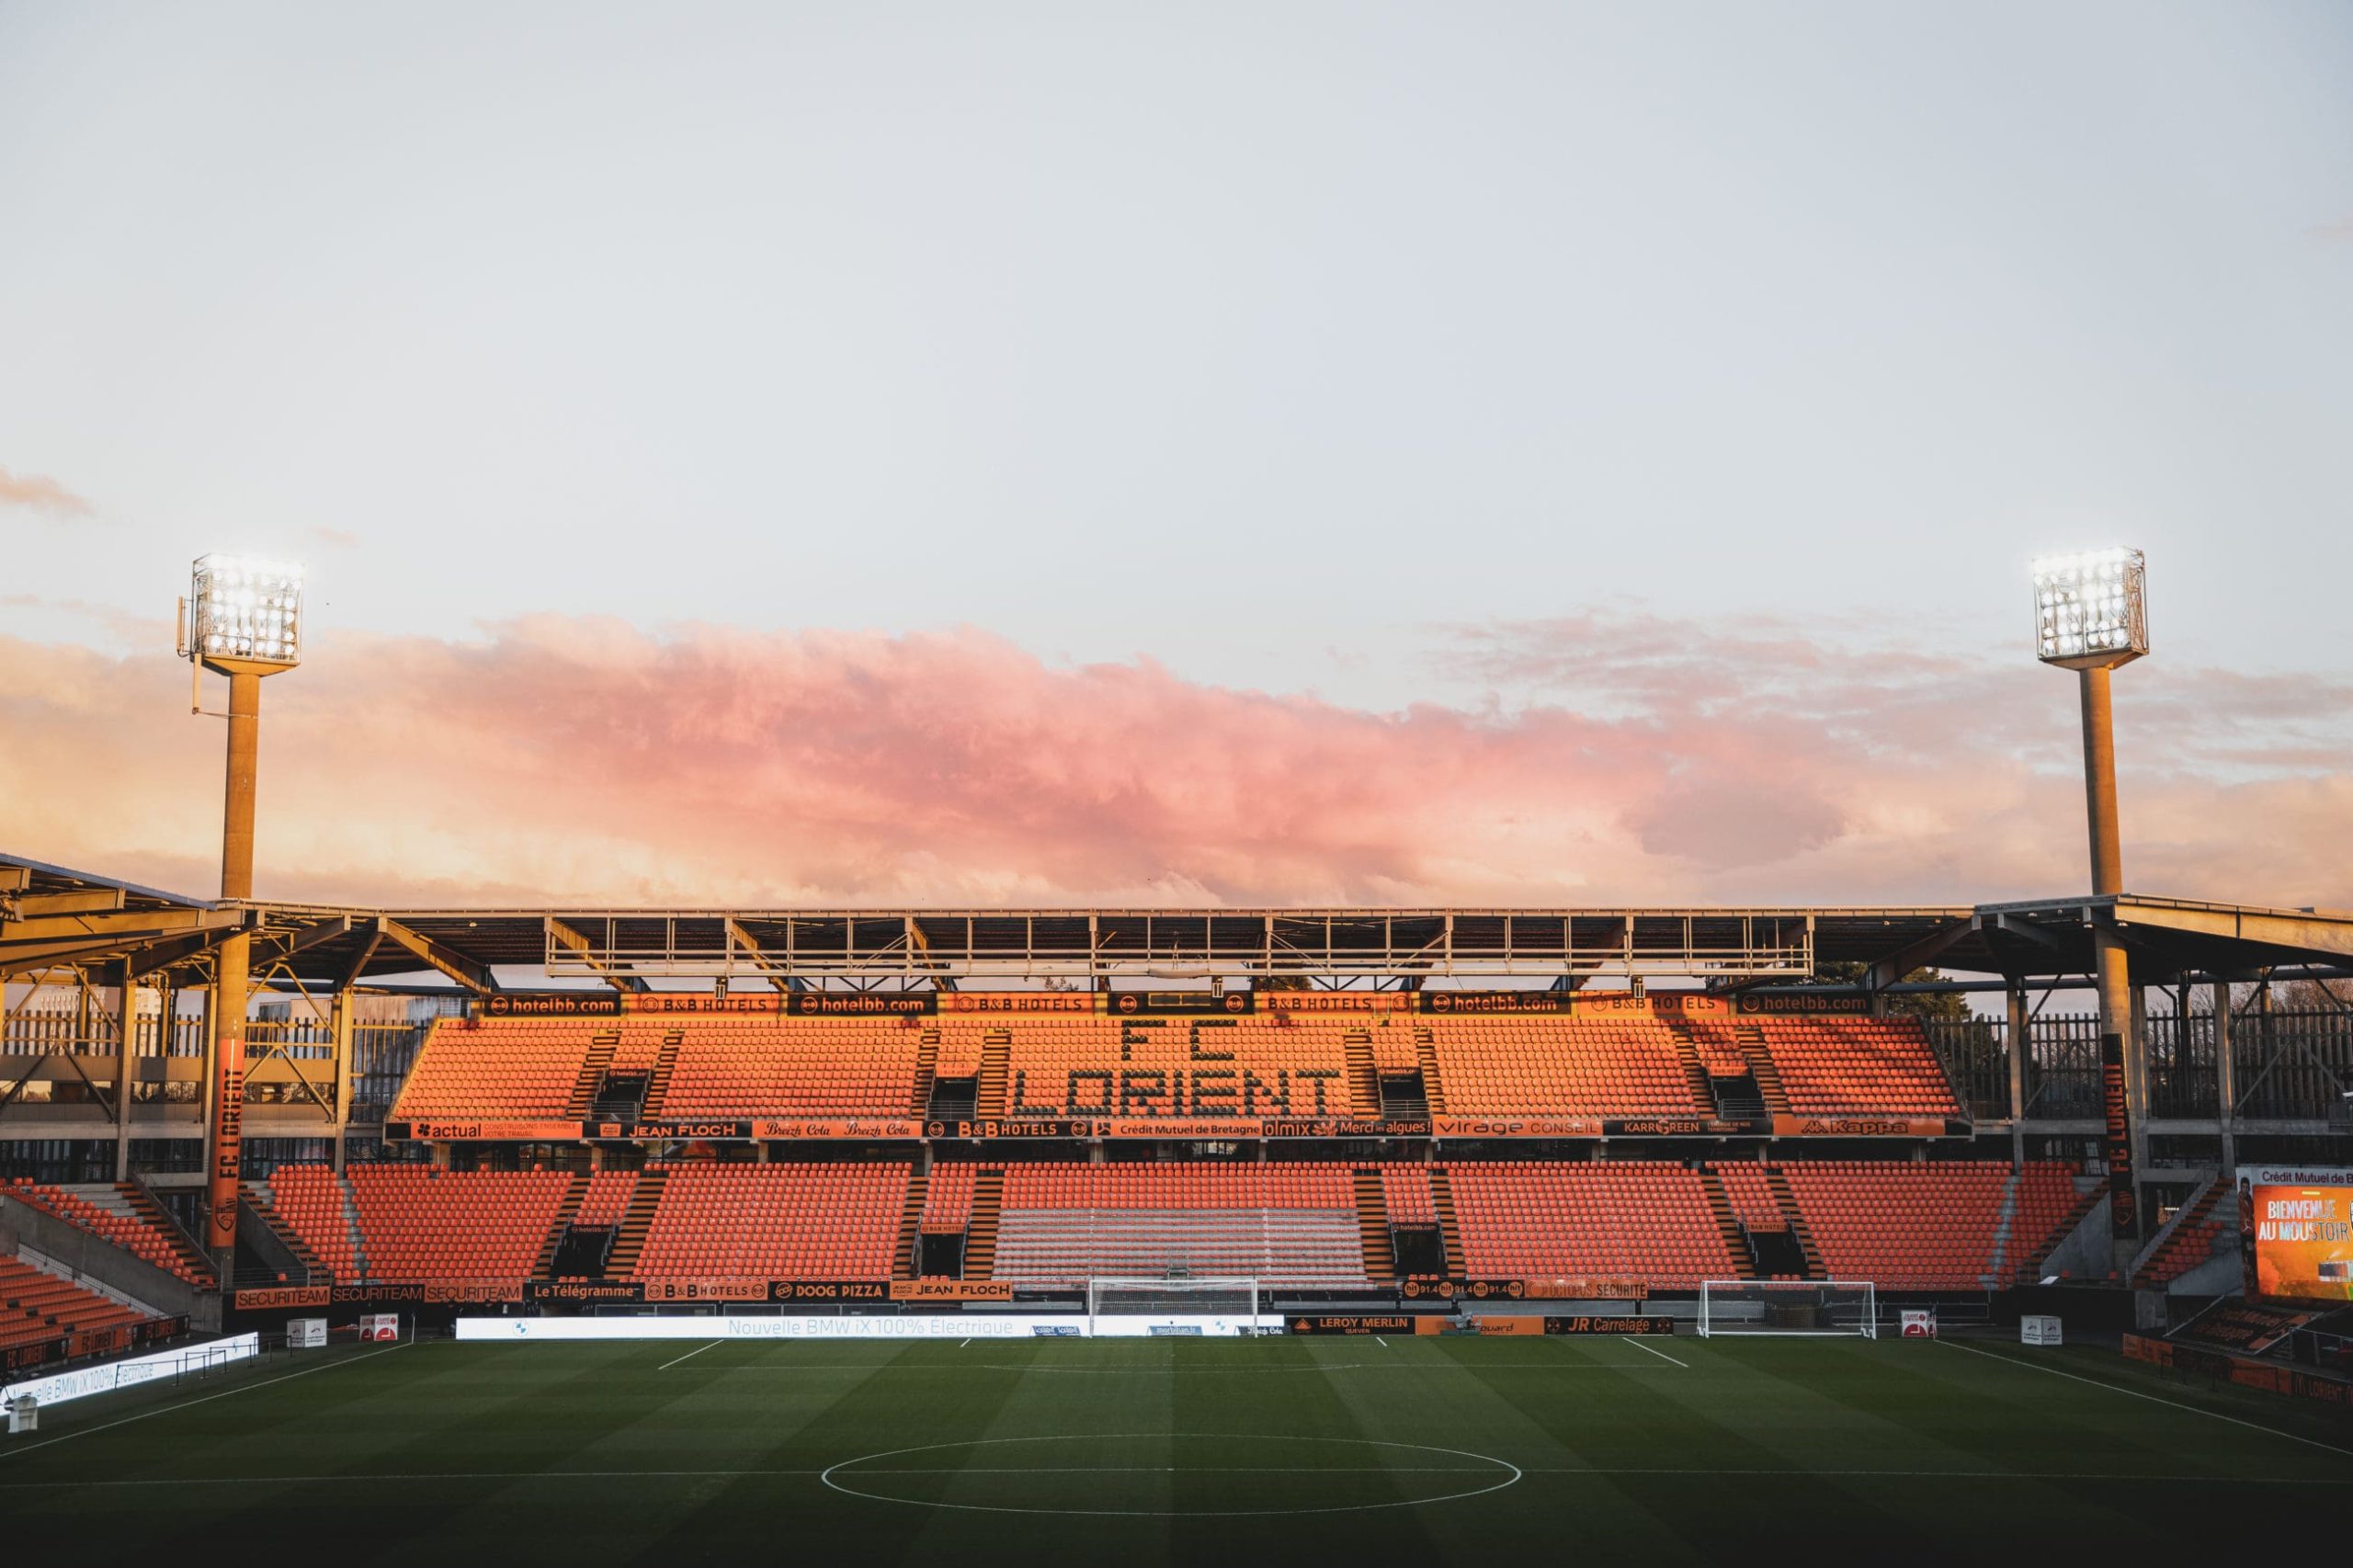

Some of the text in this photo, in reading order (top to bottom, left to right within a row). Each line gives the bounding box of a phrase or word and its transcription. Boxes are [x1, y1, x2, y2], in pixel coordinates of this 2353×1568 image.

[512, 997, 614, 1012] hotelbb.com
[664, 998, 767, 1011] B&B HOTELS
[823, 996, 924, 1012] hotelbb.com
[979, 998, 1082, 1010] B&B HOTELS
[1268, 997, 1372, 1010] B&B HOTELS
[1454, 995, 1557, 1011] hotelbb.com
[1612, 996, 1715, 1009] B&B HOTELS
[1764, 994, 1867, 1010] hotelbb.com
[1012, 1069, 1341, 1116] LORIENT
[221, 1068, 243, 1147] LORIENT
[2102, 1062, 2128, 1142] LORIENT
[432, 1122, 482, 1138] actual
[629, 1124, 672, 1138] JEAN
[765, 1121, 831, 1137] Breizh Cola
[844, 1121, 910, 1138] Breizh Cola
[959, 1121, 999, 1138] B&B
[1001, 1123, 1057, 1136] HOTELS
[1120, 1123, 1260, 1136] Crédit Mutuel de Bretagne
[1265, 1120, 1310, 1137] olmix
[1339, 1121, 1374, 1133] Merci
[1530, 1122, 1597, 1133] CONSEIL
[1830, 1120, 1908, 1135] Kappa
[219, 1154, 238, 1179] FC
[2109, 1148, 2131, 1173] FC
[2262, 1171, 2291, 1182] Crédit
[2294, 1173, 2329, 1183] Mutuel
[2331, 1173, 2344, 1184] de
[2268, 1199, 2337, 1220] BIENVENUE
[2258, 1221, 2349, 1243] AU MOUSTOIR
[332, 1287, 423, 1302] SECURITEAM
[426, 1286, 520, 1301] SECURITEAM
[534, 1284, 634, 1299] Le Télégramme
[665, 1284, 748, 1298] B&B HOTELS
[795, 1285, 836, 1297] DOOG
[841, 1285, 883, 1297] PIZZA
[916, 1283, 953, 1295] JEAN
[239, 1289, 328, 1307] SECURITEAM
[728, 1315, 1014, 1338] Nouvelle BMW iX 100% Électrique
[1319, 1318, 1408, 1328] LEROY MERLIN
[1567, 1317, 1651, 1335] JR Carrelage
[54, 1373, 77, 1399] BMW
